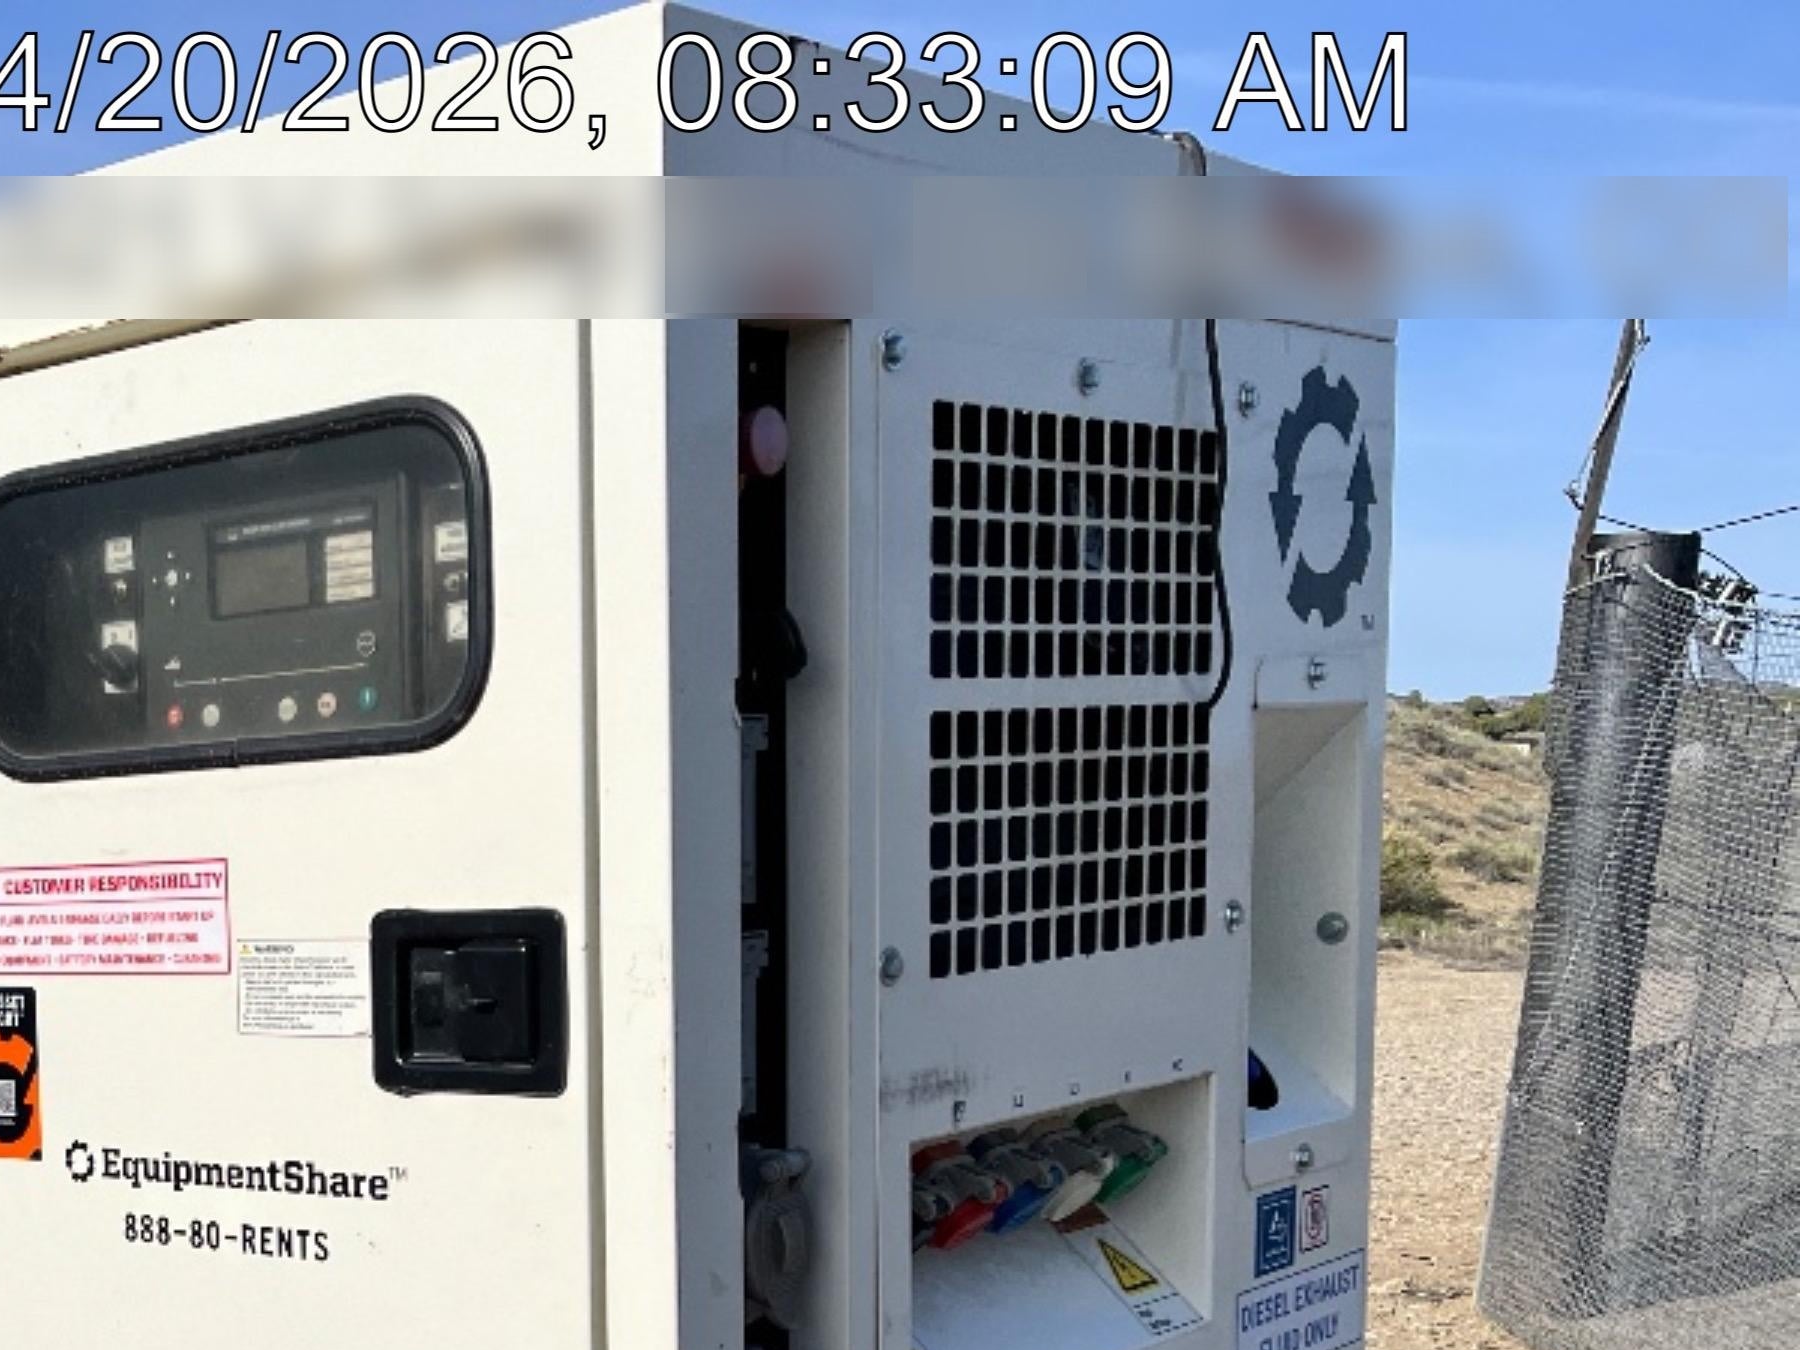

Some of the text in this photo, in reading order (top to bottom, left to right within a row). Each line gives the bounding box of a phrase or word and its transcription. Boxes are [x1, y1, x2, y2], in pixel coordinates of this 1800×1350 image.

[4, 877, 85, 895] CUSTOMER
[88, 872, 224, 893] RESPONSIBILITY
[124, 1211, 330, 1262] 888-80-RENTS
[1241, 1264, 1360, 1333] DIESEL EXHAUST
[1304, 1311, 1340, 1348] ONLY
